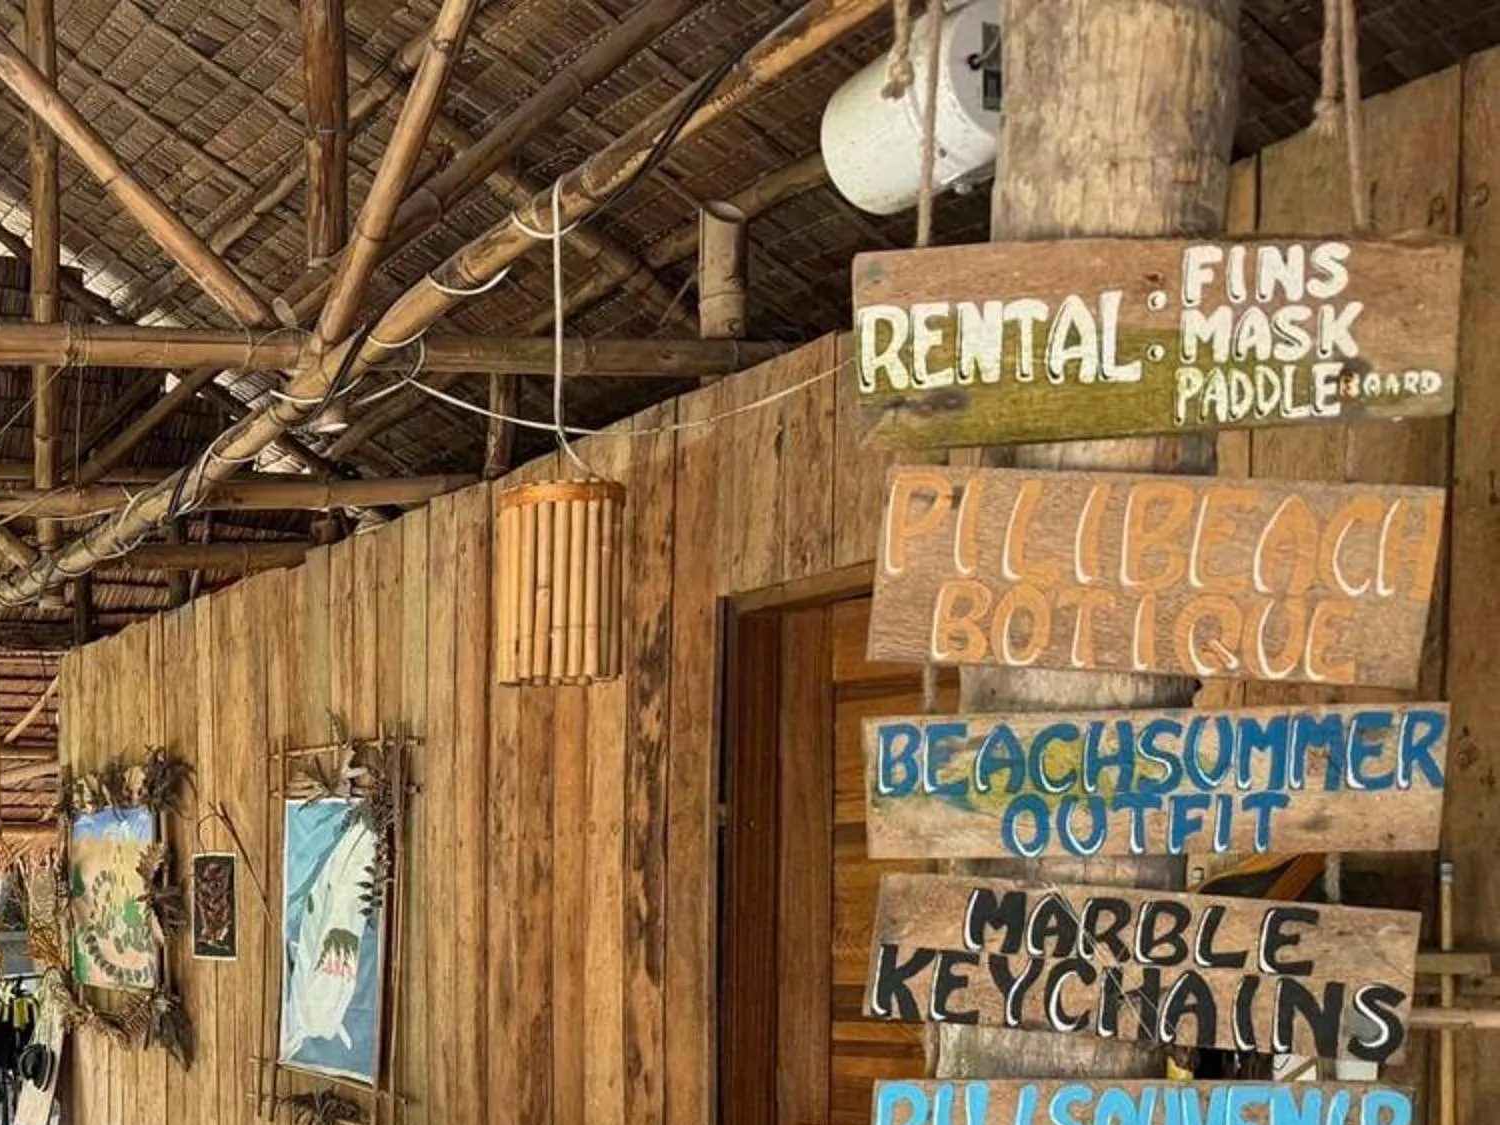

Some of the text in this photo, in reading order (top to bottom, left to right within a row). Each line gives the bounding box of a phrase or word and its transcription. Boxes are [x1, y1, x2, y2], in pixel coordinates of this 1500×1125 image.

[1180, 242, 1350, 307] FINS
[1178, 302, 1363, 364] MASK
[931, 580, 1357, 683] BOTIQUE
[1001, 791, 1290, 859] OUTFIT
[964, 886, 1319, 976] MARBLE
[870, 942, 1407, 1062] KEYCHAINS
